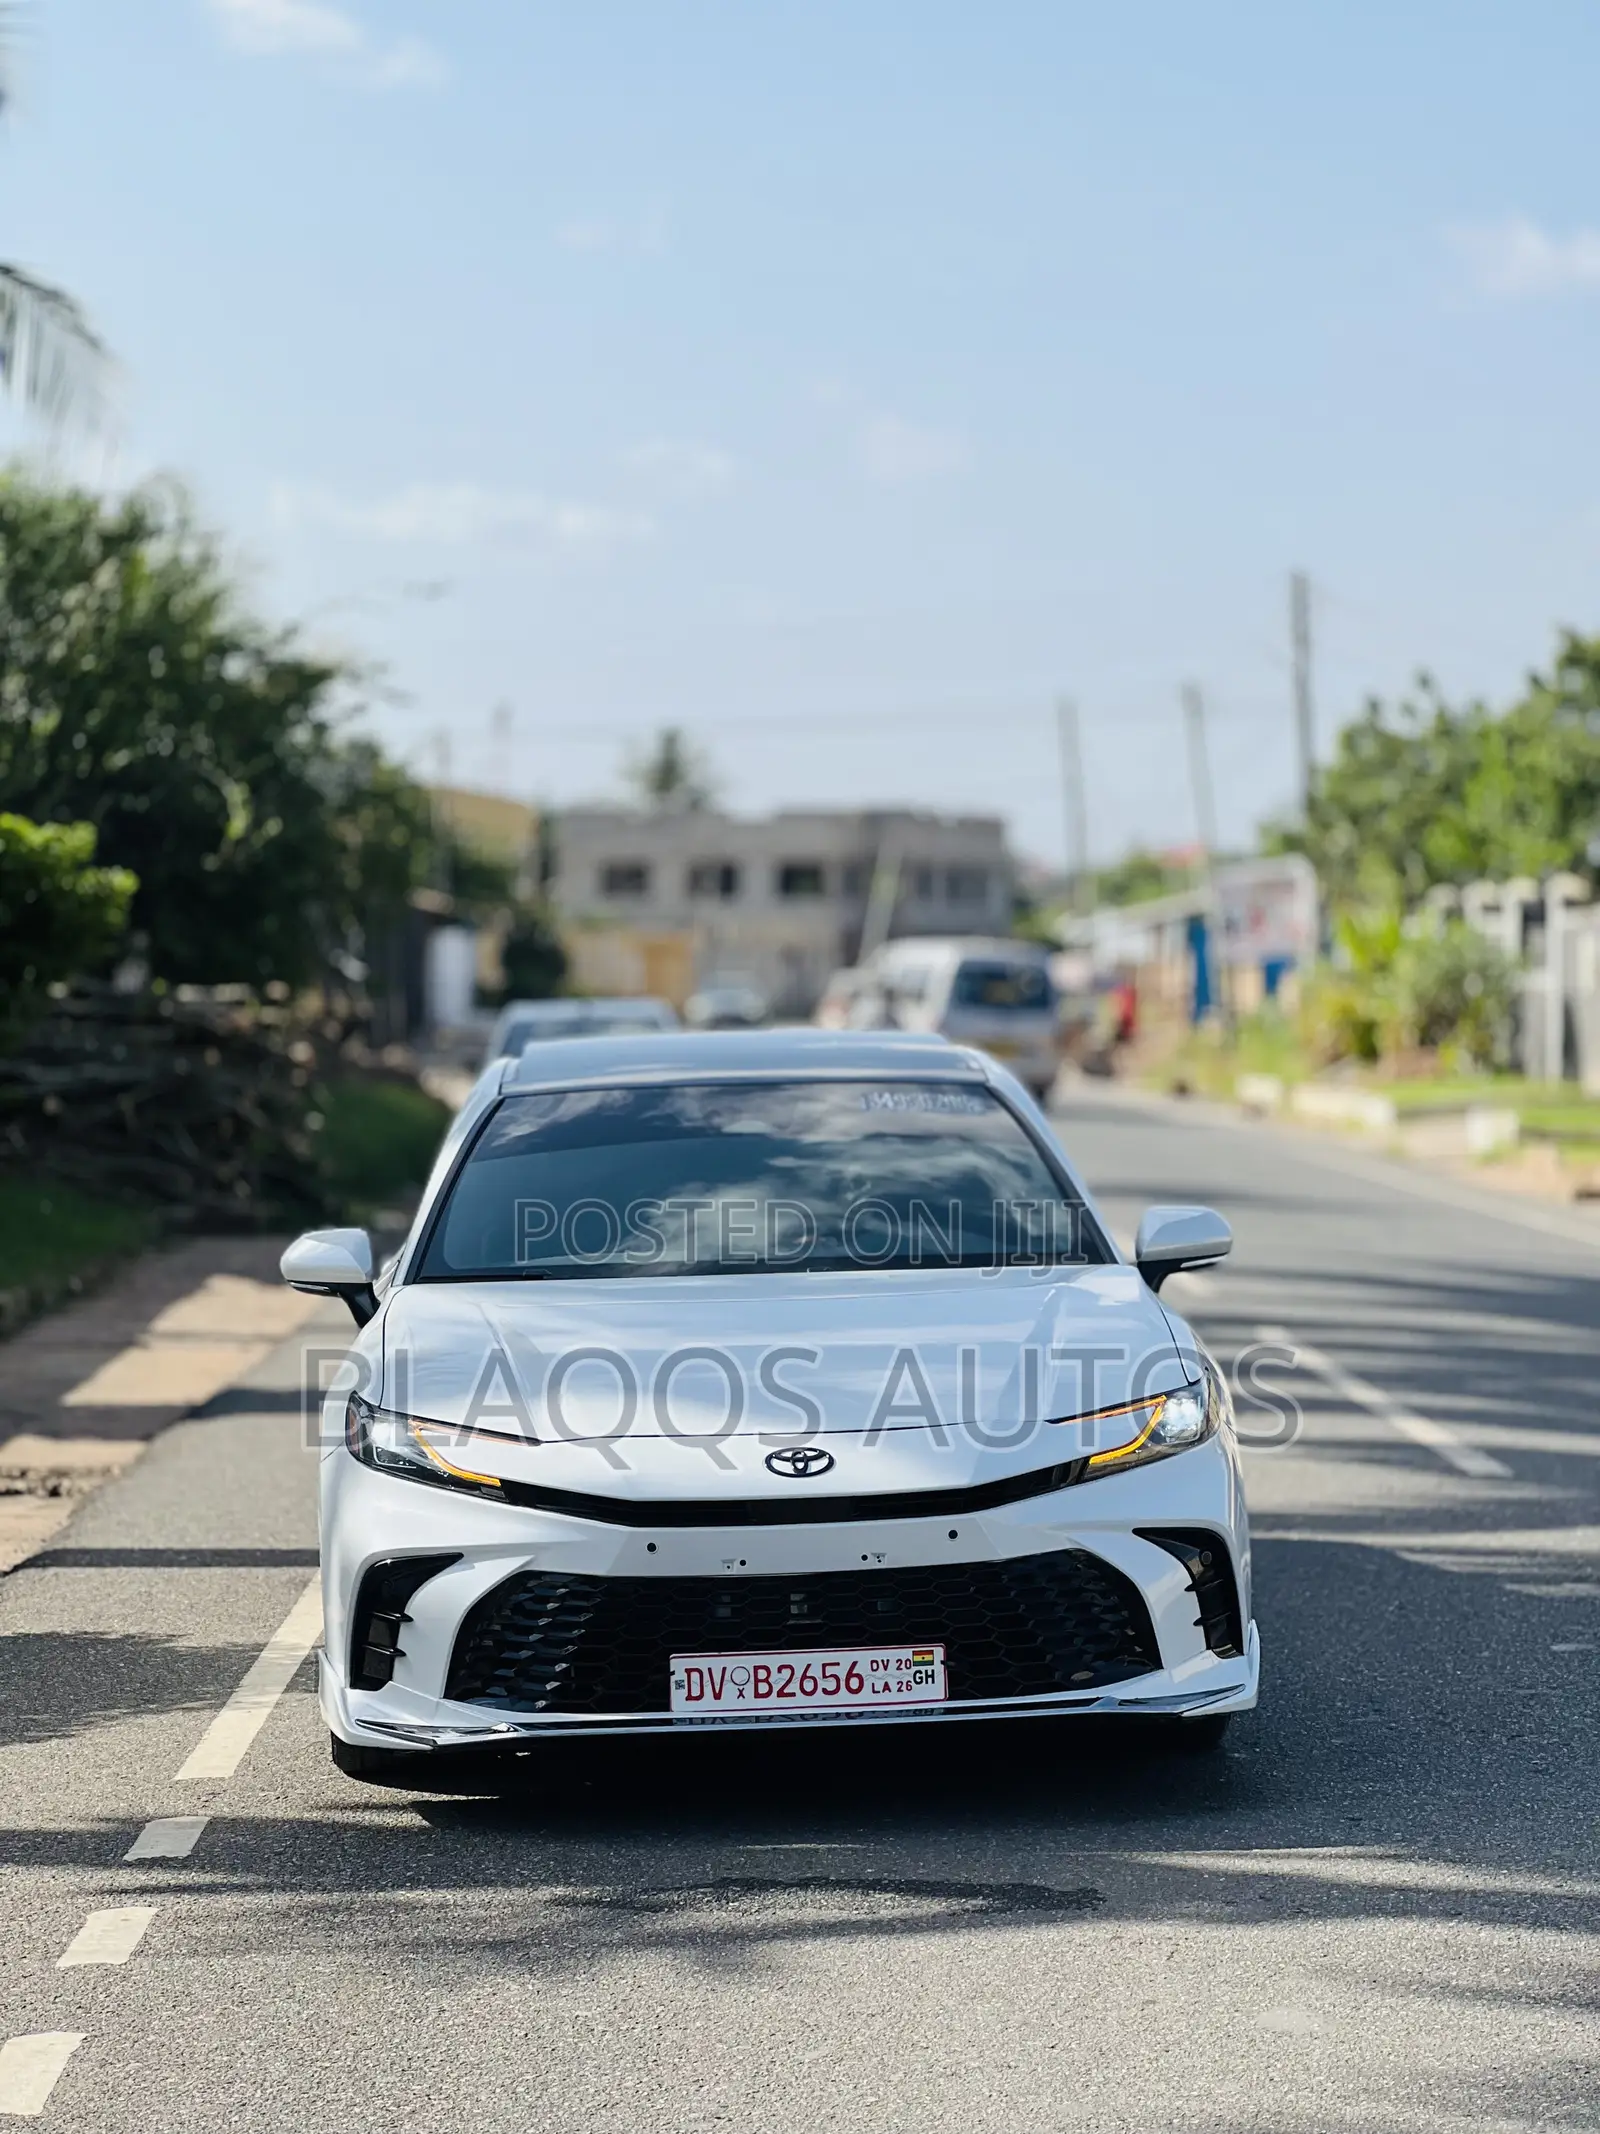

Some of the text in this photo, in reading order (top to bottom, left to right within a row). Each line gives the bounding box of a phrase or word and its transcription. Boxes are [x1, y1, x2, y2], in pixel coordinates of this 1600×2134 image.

[870, 1658, 912, 1672] DV 20
[685, 1667, 727, 1701] DV
[753, 1661, 865, 1699] B2656
[913, 1669, 935, 1685] GH
[872, 1681, 913, 1694] LA 26
